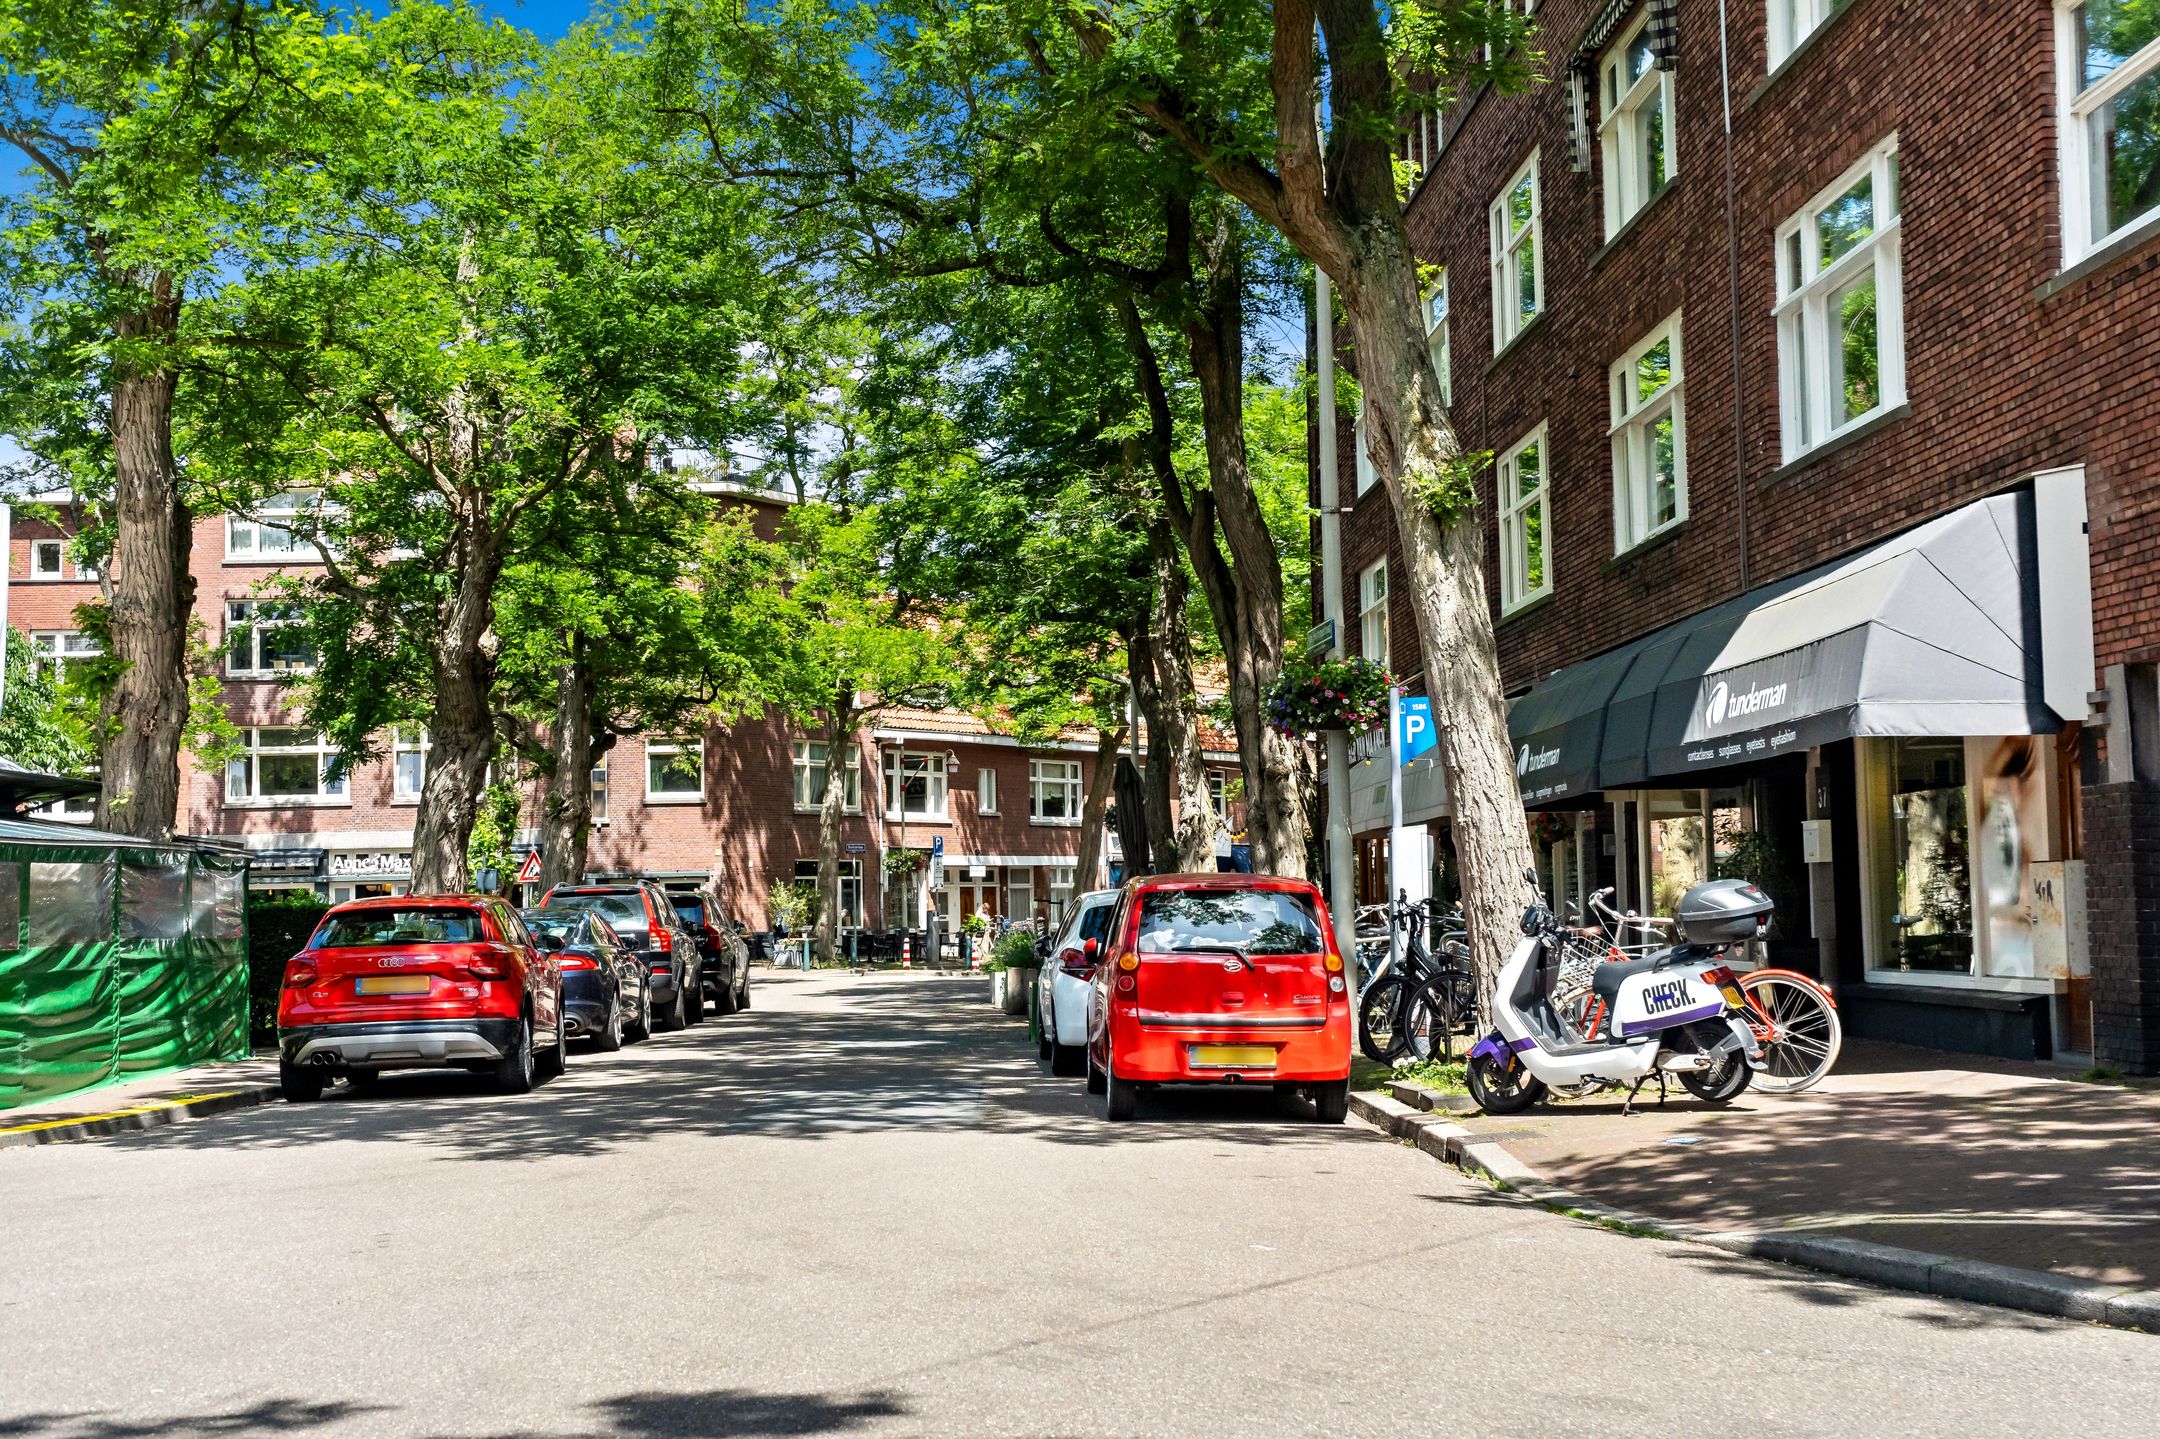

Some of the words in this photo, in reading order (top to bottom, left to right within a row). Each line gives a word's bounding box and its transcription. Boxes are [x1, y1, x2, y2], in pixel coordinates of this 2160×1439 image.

[1412, 703, 1427, 711] 1586
[1728, 682, 1787, 718] tunderman
[1406, 715, 1425, 744] P
[1528, 745, 1560, 772] tunderman
